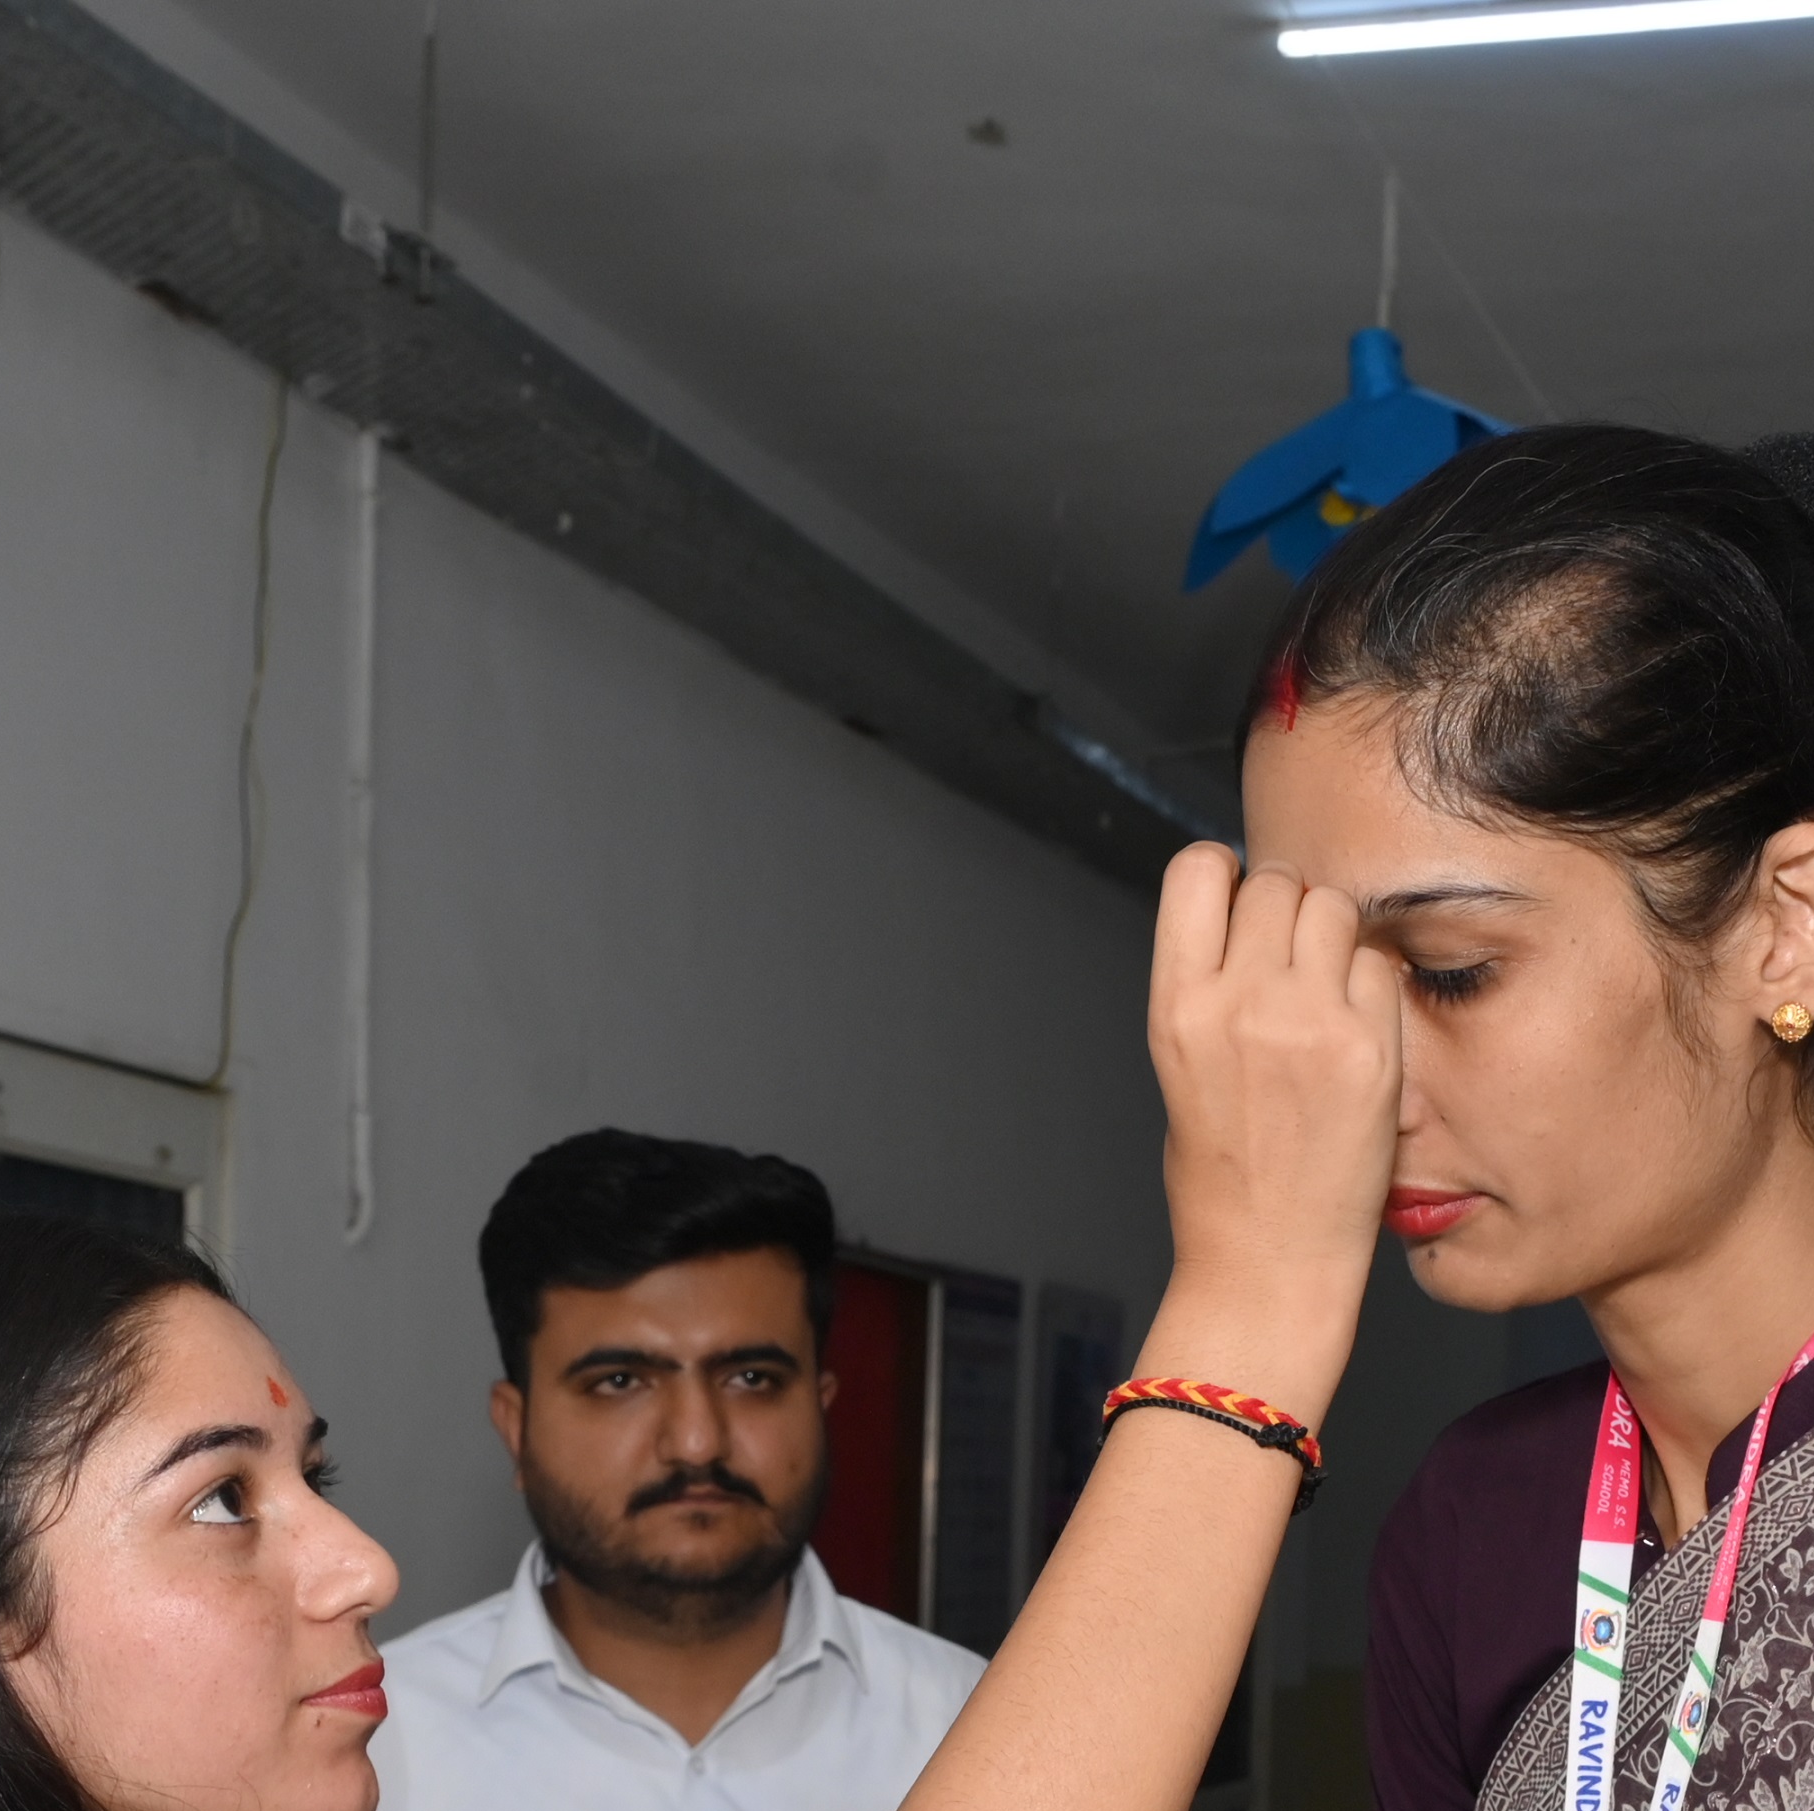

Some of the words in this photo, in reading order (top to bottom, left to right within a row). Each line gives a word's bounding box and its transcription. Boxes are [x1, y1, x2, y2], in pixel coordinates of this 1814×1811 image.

[1596, 1463, 1615, 1515] SCHOOL
[1616, 1458, 1632, 1500] MEMO.
[1613, 1503, 1628, 1529] S.S.
